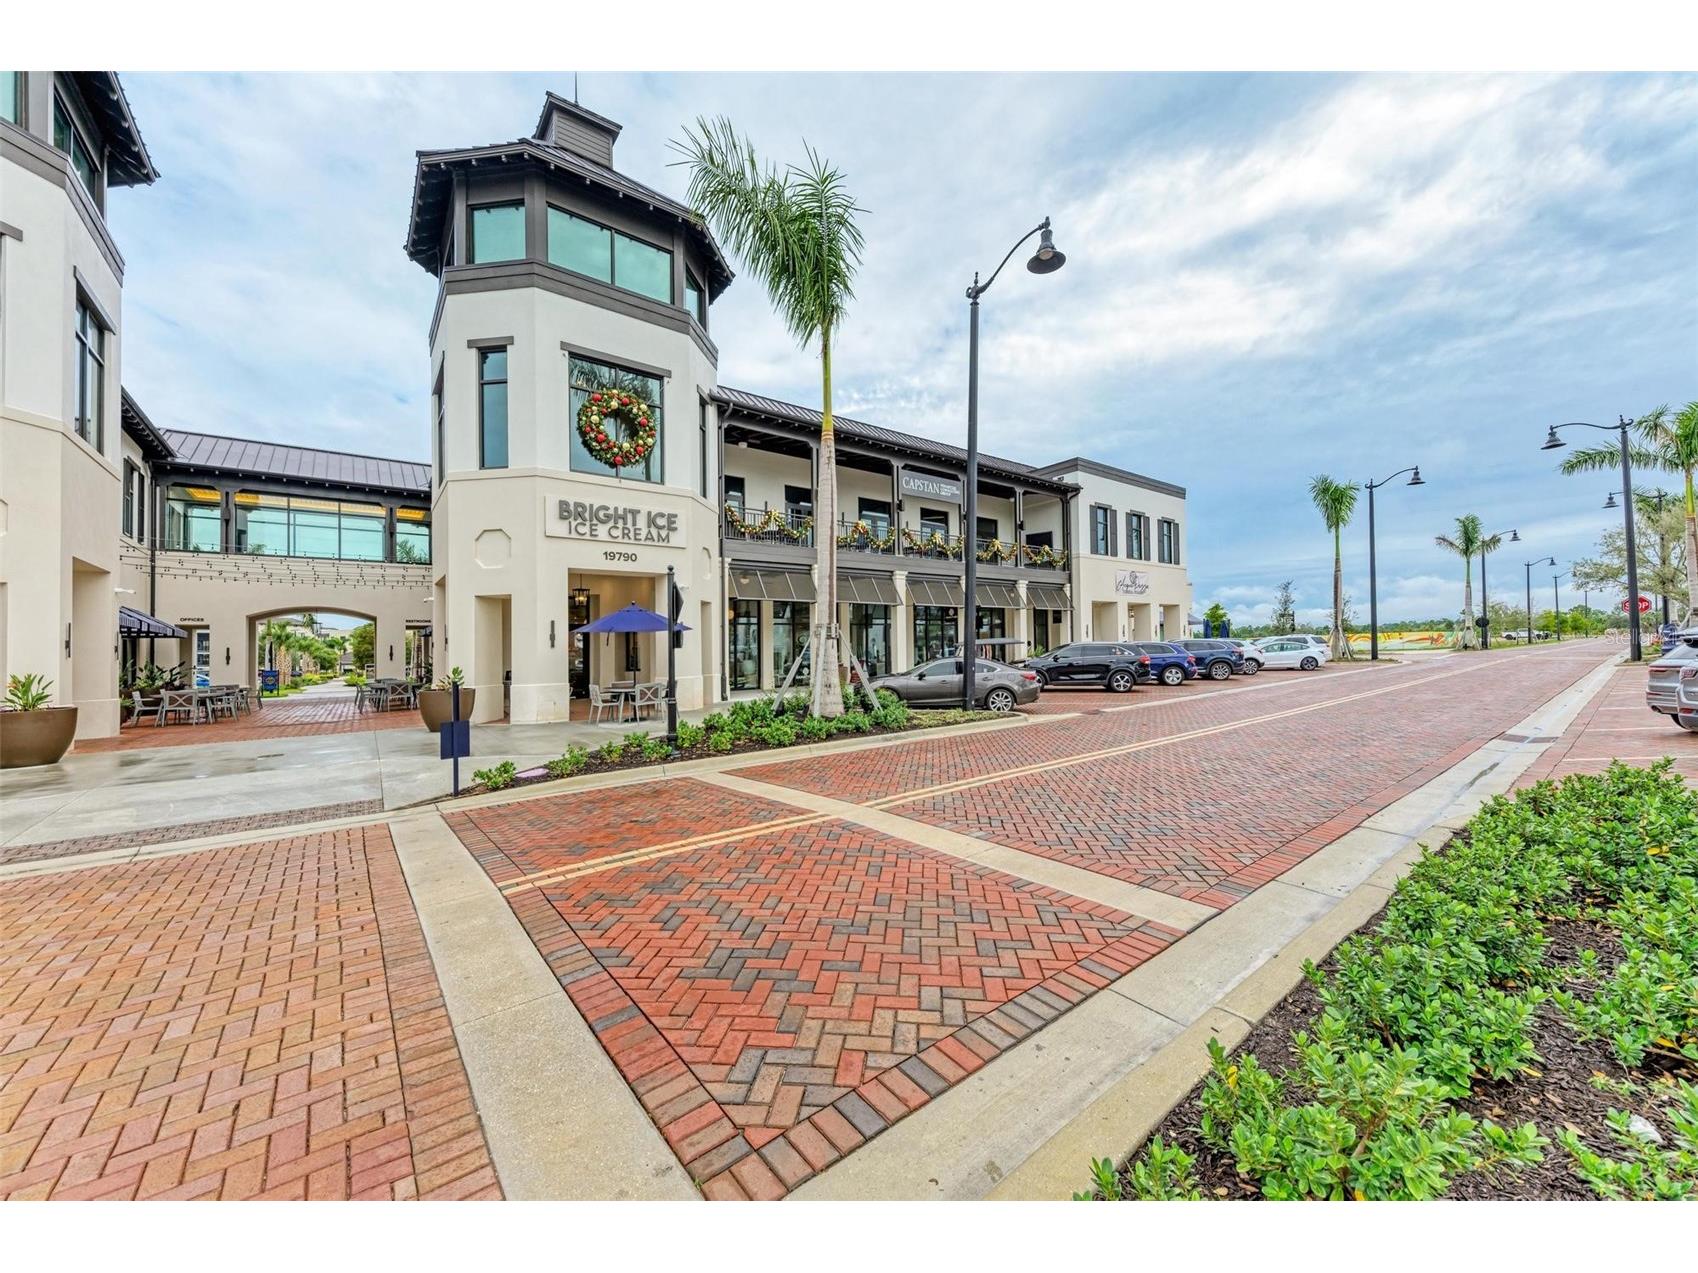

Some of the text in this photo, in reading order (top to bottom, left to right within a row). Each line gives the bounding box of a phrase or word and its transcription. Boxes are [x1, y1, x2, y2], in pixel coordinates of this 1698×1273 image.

[902, 476, 940, 494] CAPSTAN
[558, 499, 678, 532] BRIGHT ICE
[568, 520, 670, 544] ICE CREAM
[603, 551, 637, 562] 19790
